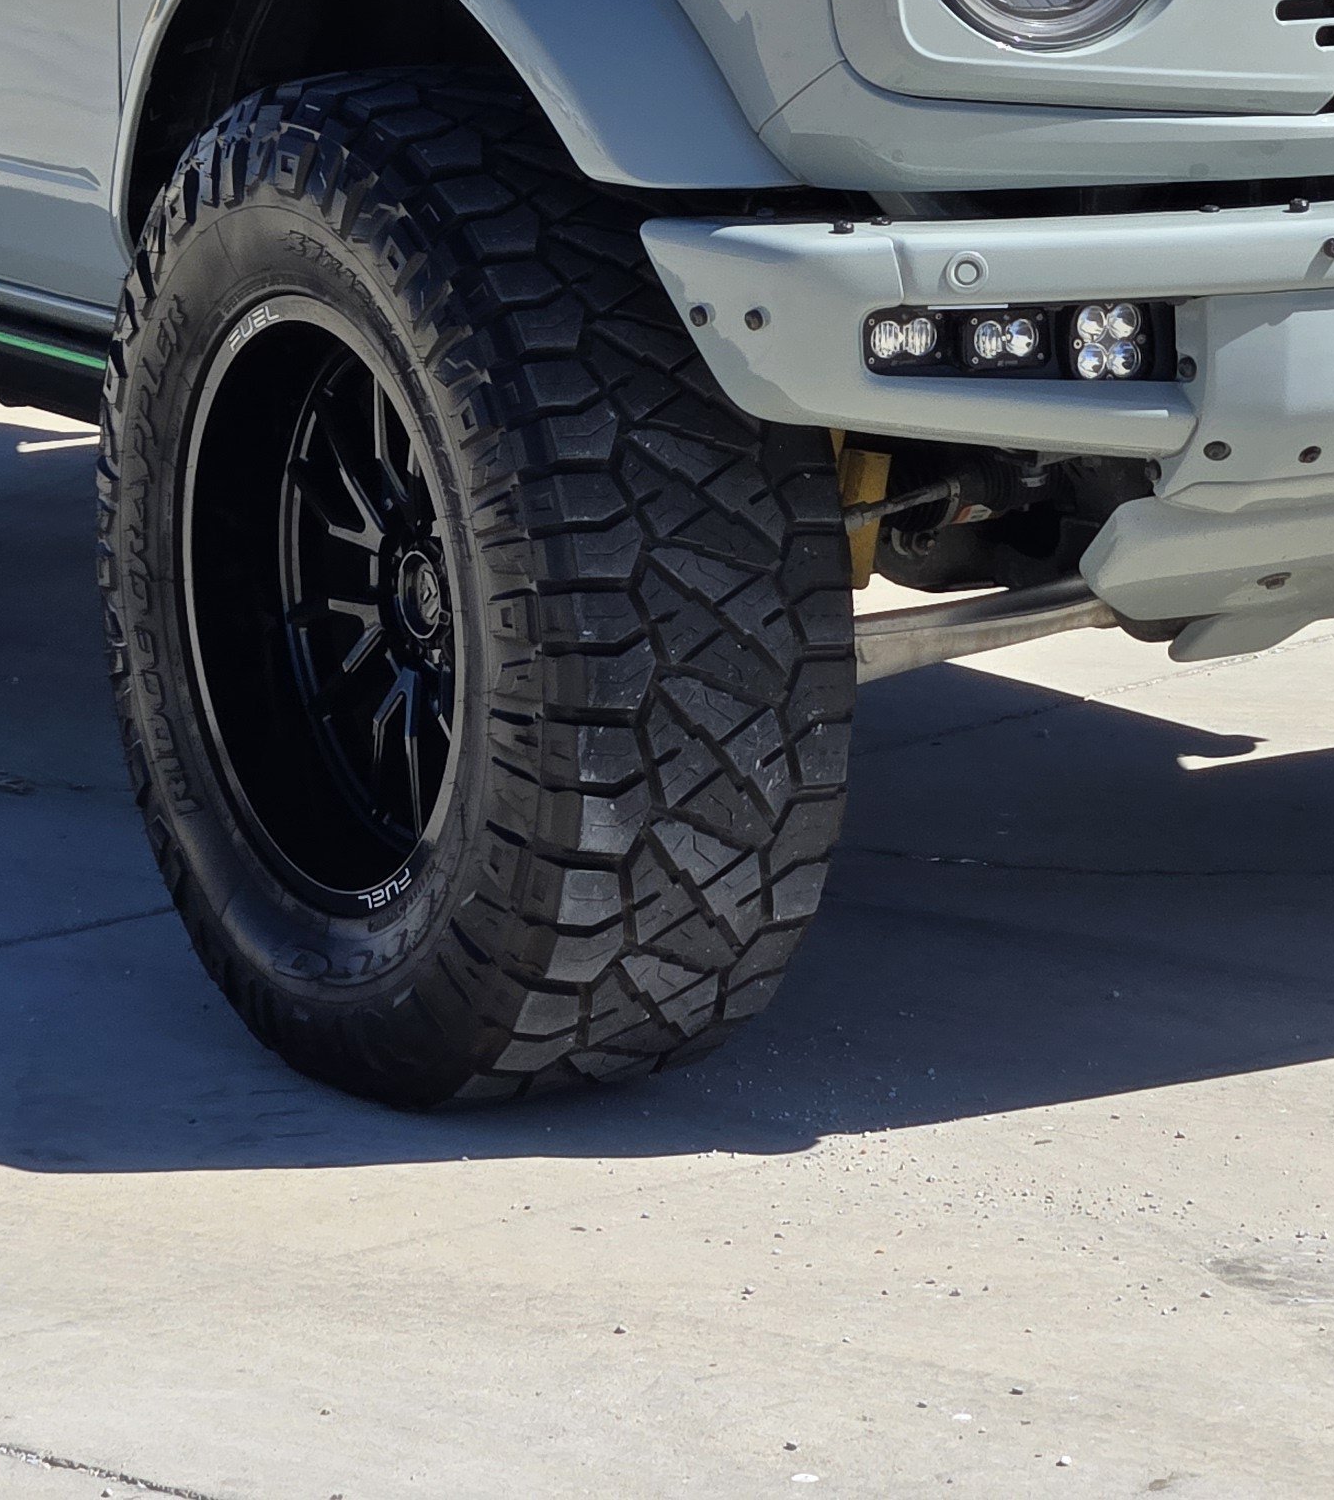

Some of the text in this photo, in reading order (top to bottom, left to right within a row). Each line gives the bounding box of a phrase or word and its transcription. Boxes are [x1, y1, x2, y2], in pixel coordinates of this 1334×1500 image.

[228, 305, 280, 352] FUEL
[132, 625, 203, 819] RIDGE
[357, 867, 413, 911] FUEL
